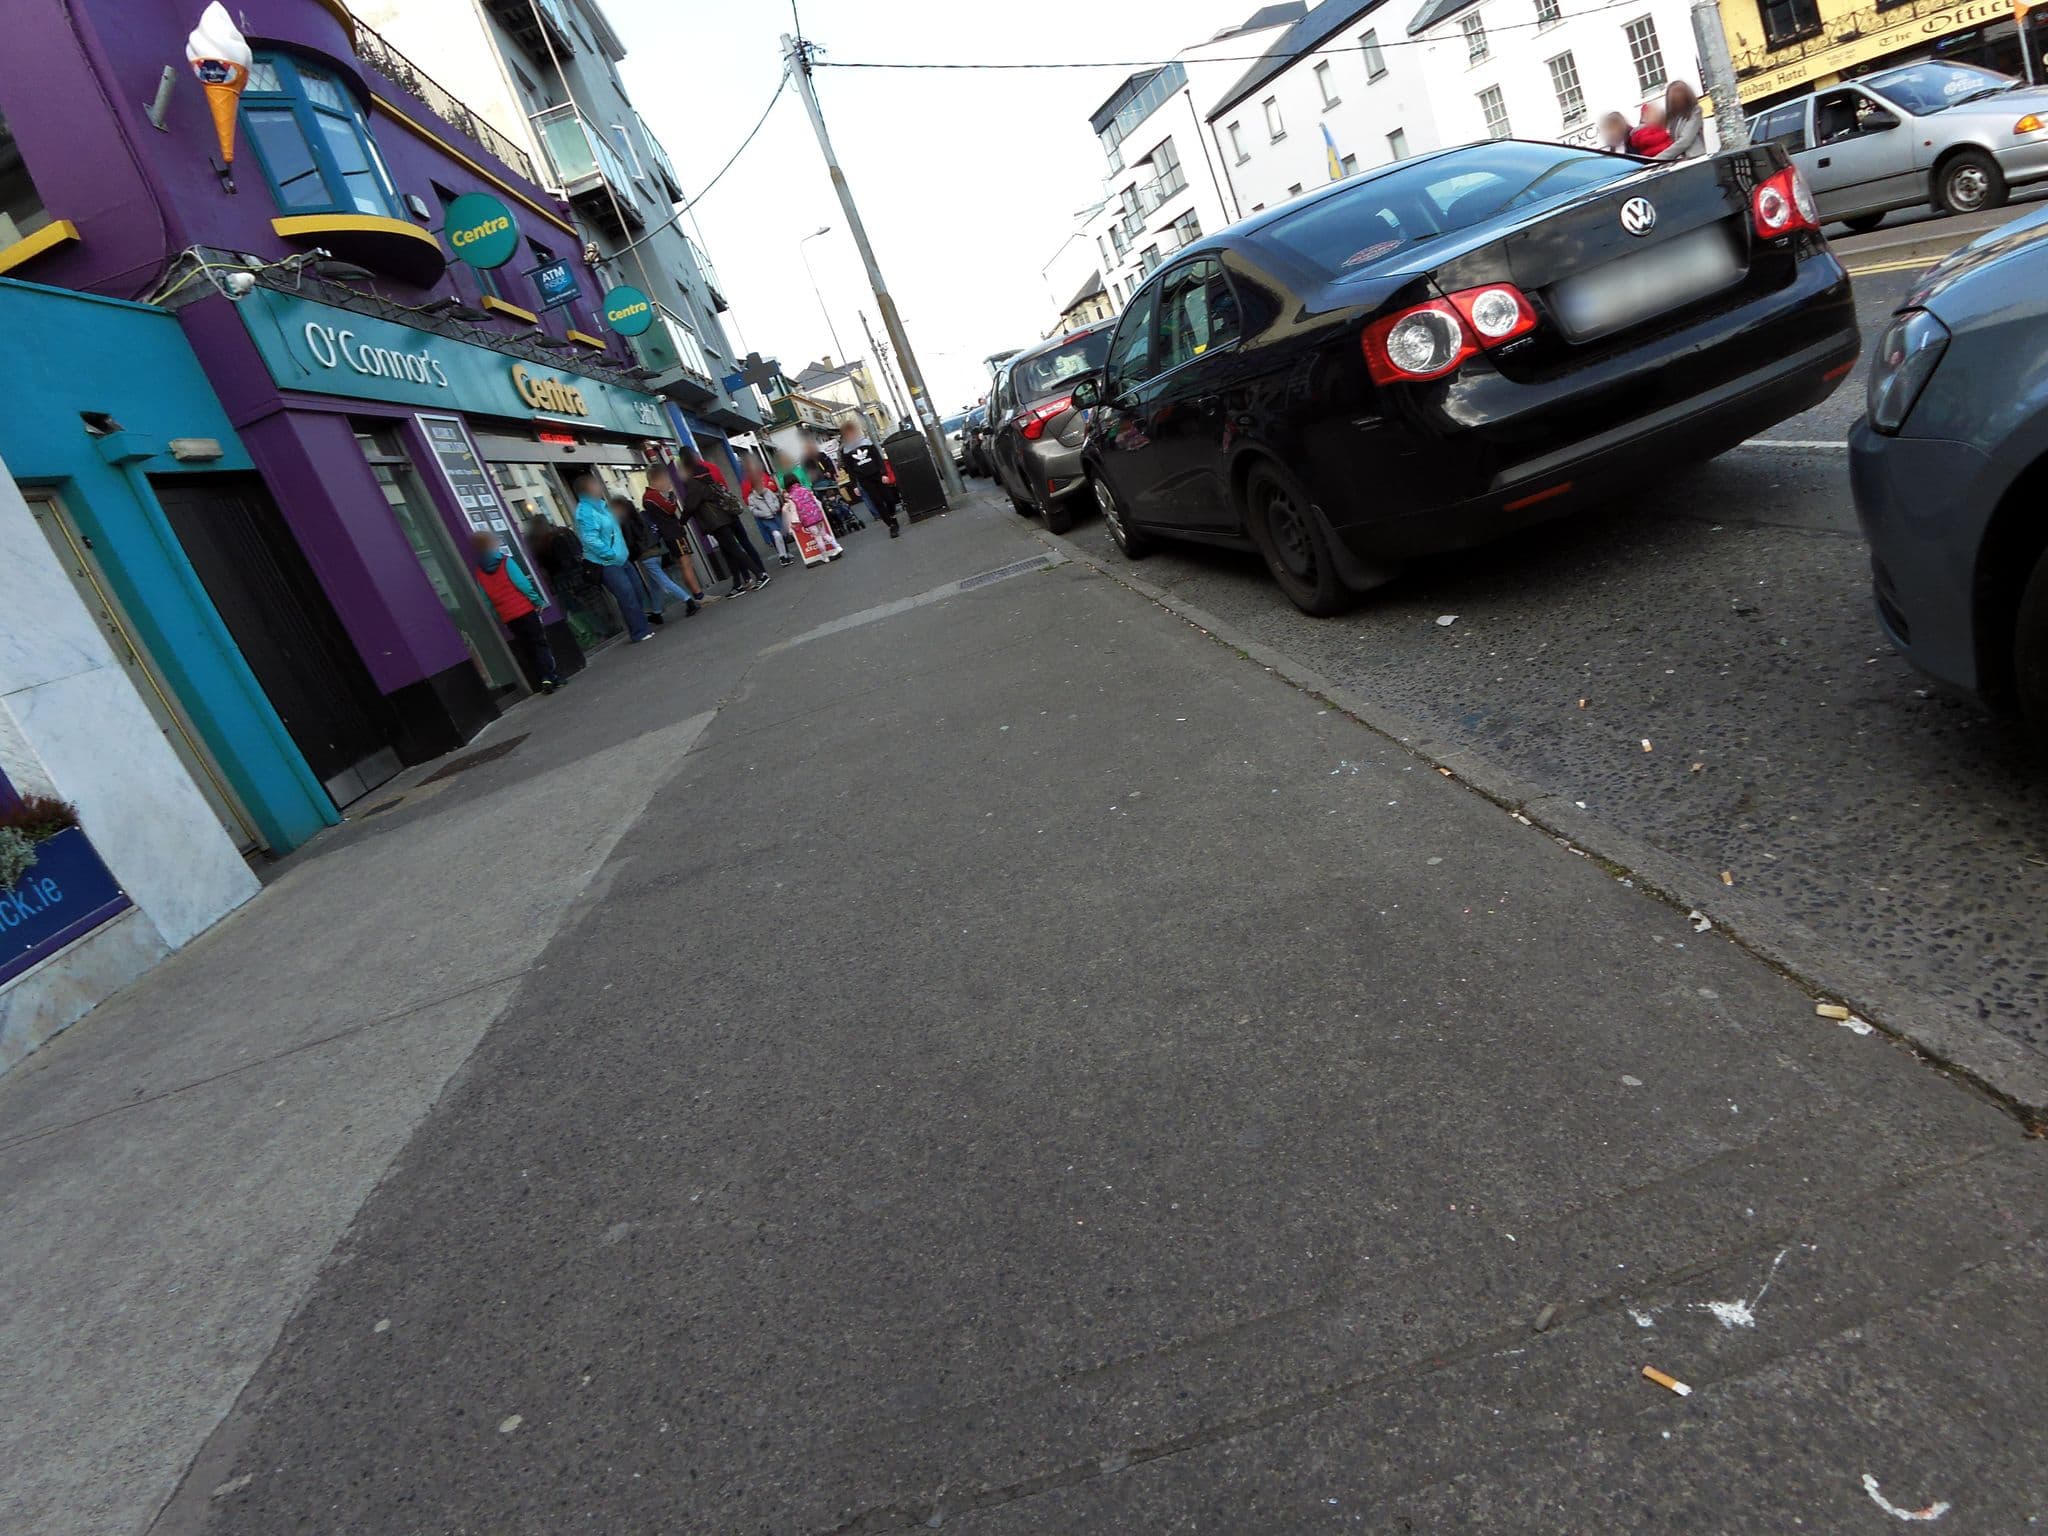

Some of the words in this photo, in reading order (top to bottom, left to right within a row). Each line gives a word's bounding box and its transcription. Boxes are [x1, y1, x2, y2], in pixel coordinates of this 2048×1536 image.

[1738, 80, 1773, 98] oliday
[1777, 66, 1807, 84] Hotel
[452, 216, 509, 247] Centra
[542, 266, 565, 282] ATM
[608, 302, 647, 321] Centra
[305, 322, 448, 387] O'Connor's
[511, 363, 589, 416] Centra
